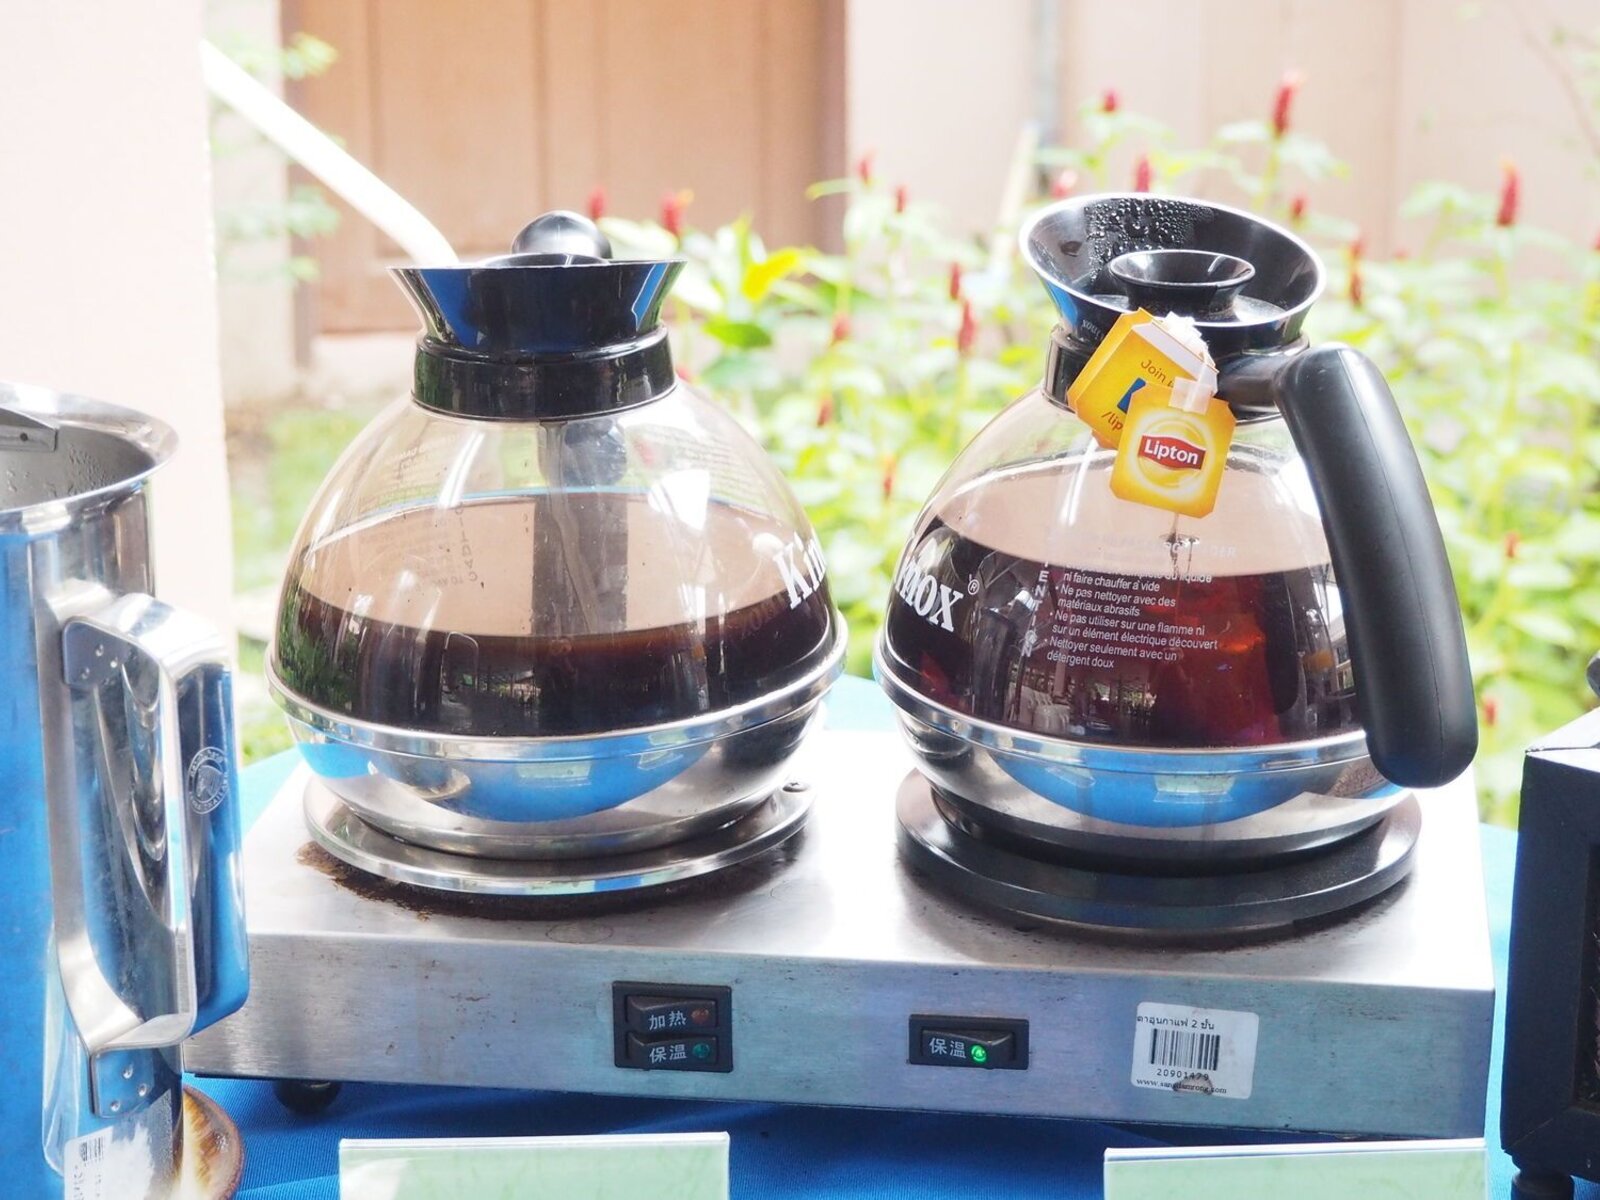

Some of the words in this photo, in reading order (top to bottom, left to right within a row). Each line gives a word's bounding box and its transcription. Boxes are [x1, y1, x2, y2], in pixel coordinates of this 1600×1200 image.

[1140, 359, 1167, 382] Join
[1101, 411, 1124, 431] /lip
[1144, 439, 1199, 466] Lipton
[1064, 573, 1072, 582] ni
[1073, 574, 1093, 586] faire
[1095, 577, 1131, 590] chauffer
[1132, 581, 1139, 590] à
[1141, 582, 1160, 591] vide
[1060, 584, 1074, 595] Ne
[1076, 588, 1092, 600] pas
[1094, 590, 1132, 606] nettoyer
[1134, 596, 1156, 606] avec
[1158, 596, 1176, 607] des
[1021, 562, 1049, 658] ENTION
[1058, 598, 1102, 612] matériaux
[1104, 604, 1140, 616] abrasifs
[1055, 610, 1068, 622] Ne
[1069, 614, 1086, 625] pas
[1089, 615, 1119, 628] utiliser
[1120, 620, 1135, 630] sur
[1137, 622, 1155, 632] une
[1157, 621, 1193, 636] flamme
[1196, 625, 1205, 636] ni
[1052, 625, 1067, 635] sur
[1069, 627, 1080, 637] un
[1082, 627, 1119, 641] élément
[1121, 632, 1167, 647] électrique
[1169, 637, 1218, 650] découvert
[1047, 649, 1090, 666] détergent
[1092, 655, 1114, 669] doux
[1049, 636, 1087, 653] Nettoyer
[1090, 642, 1137, 657] seulement
[1139, 649, 1162, 659] avec
[1164, 651, 1177, 661] un
[648, 1010, 687, 1031] 加热
[1191, 1019, 1198, 1029] 2
[648, 1043, 688, 1064] 保温
[929, 1037, 967, 1059] 保温
[1156, 1068, 1210, 1081] 20901479
